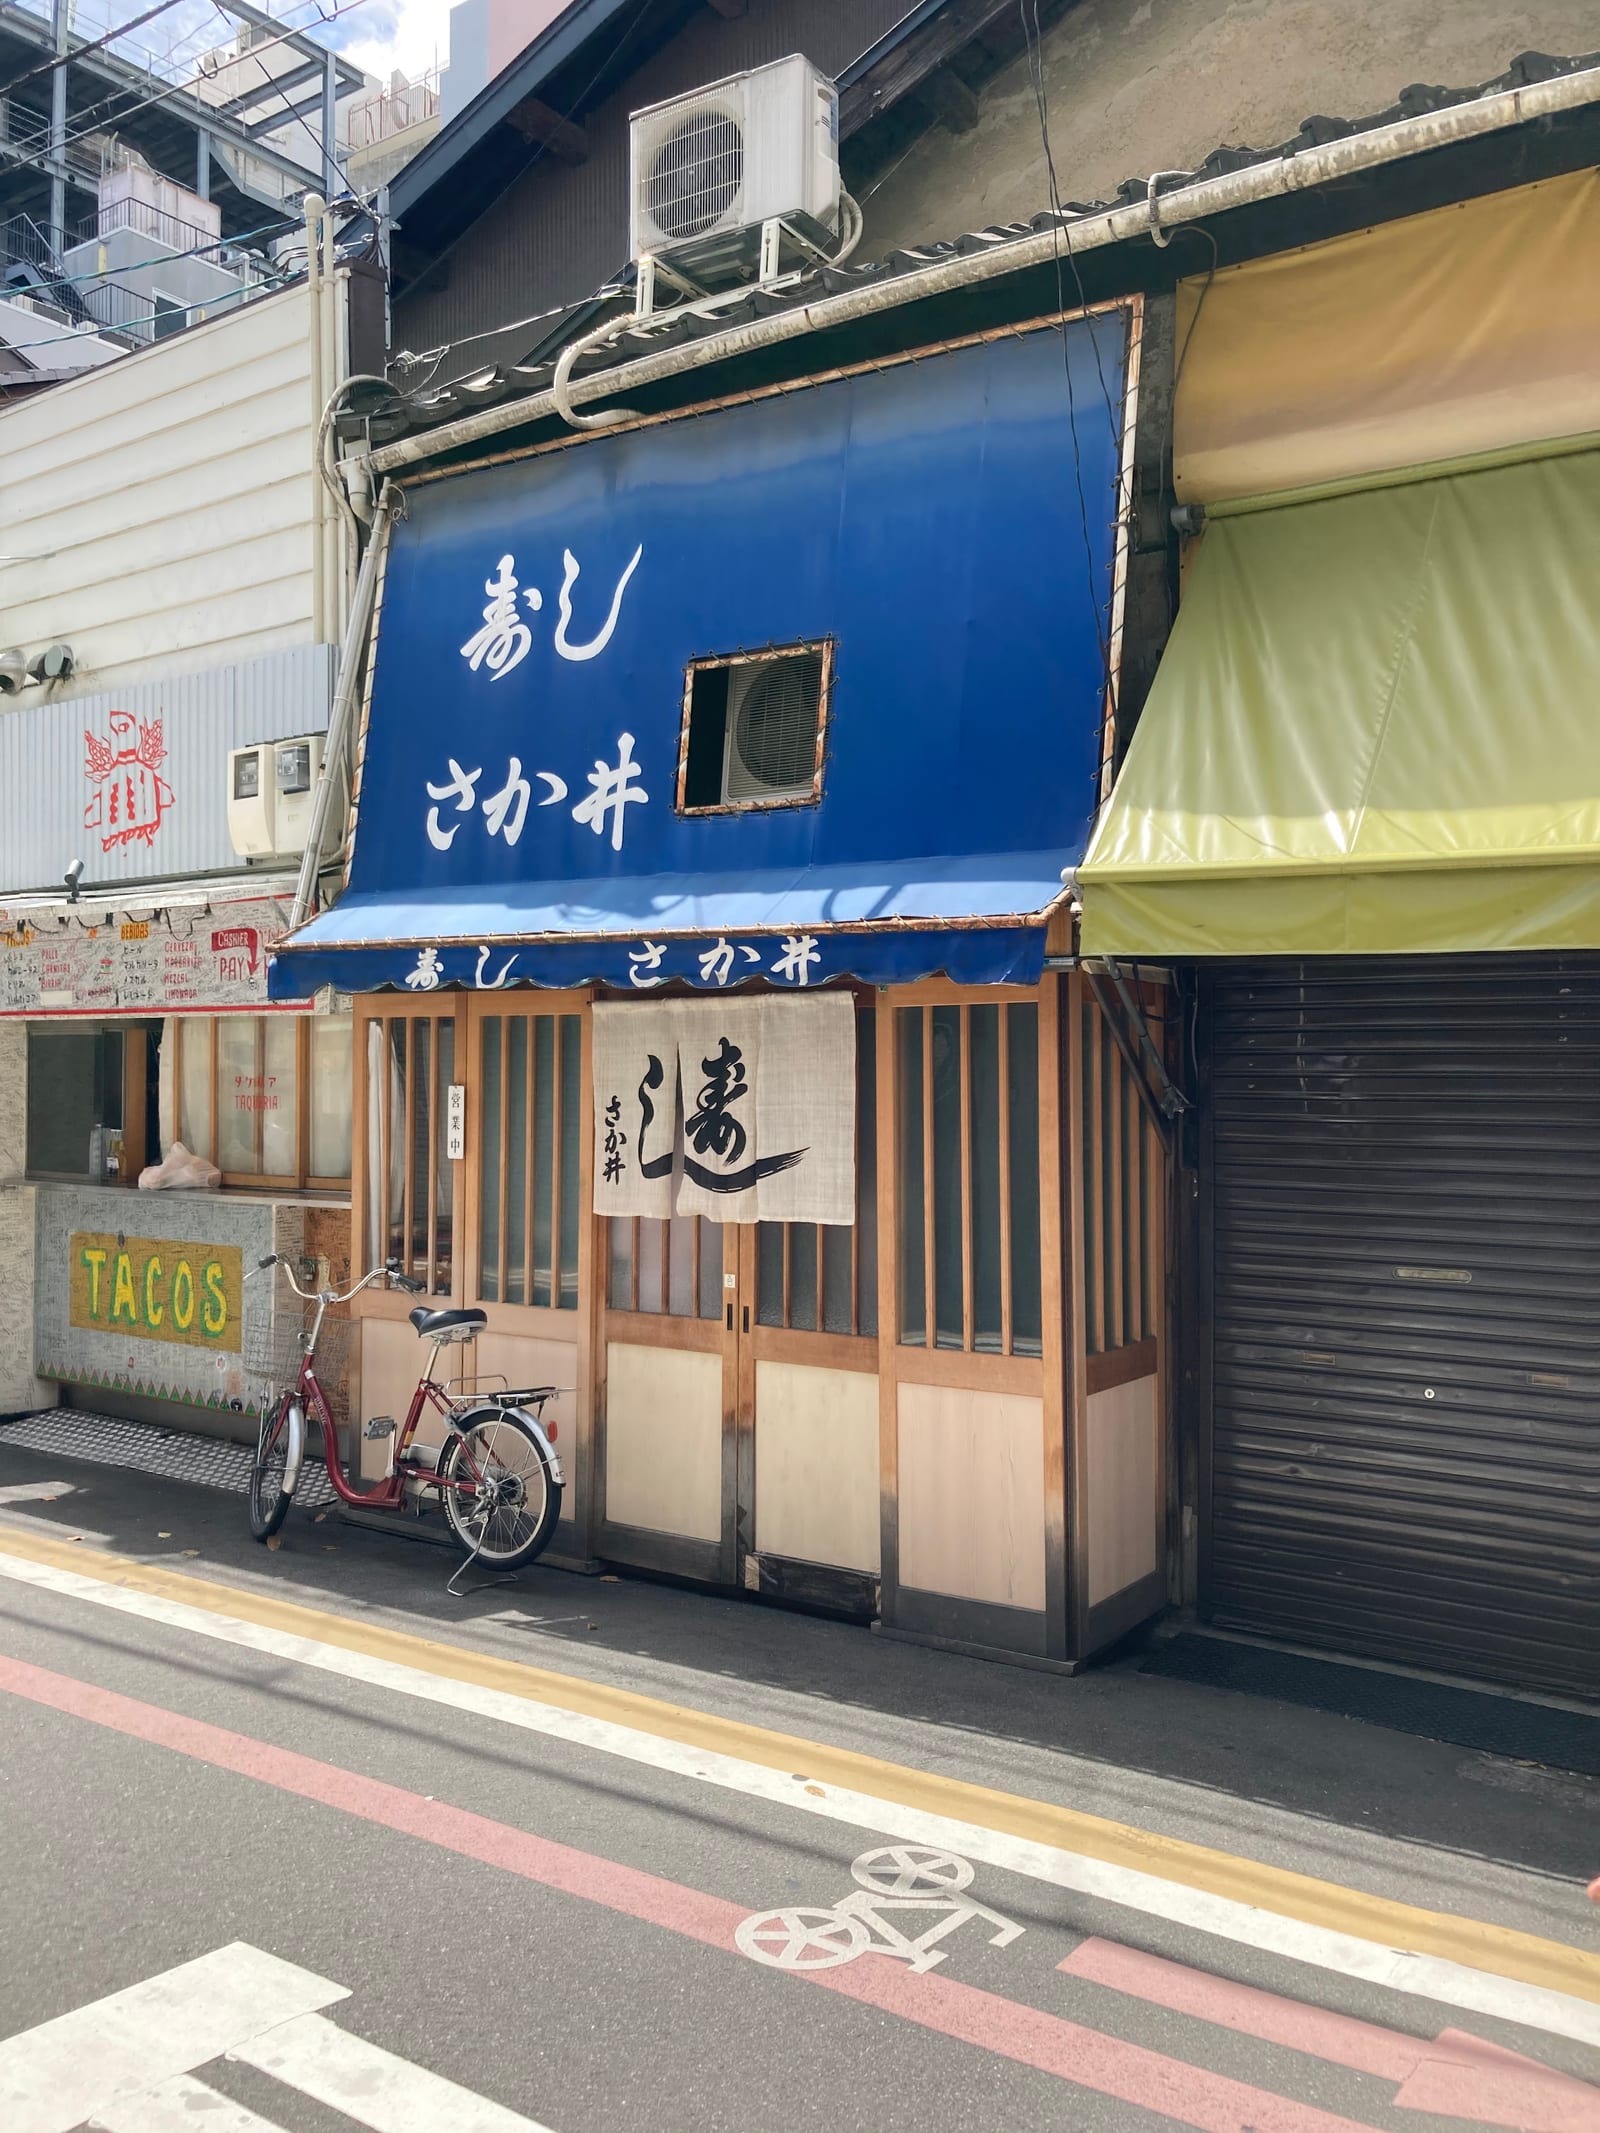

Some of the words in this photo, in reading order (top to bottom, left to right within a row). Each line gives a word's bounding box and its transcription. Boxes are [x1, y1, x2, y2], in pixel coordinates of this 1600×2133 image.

[460, 543, 643, 681] 寿し
[426, 732, 649, 851] さか井
[6, 929, 31, 947] TAOS
[121, 923, 149, 940] BEBIDAS
[218, 931, 249, 947] CASHIER
[219, 956, 244, 982] PAY
[405, 946, 519, 990] 寿し
[629, 935, 822, 988] さか井
[451, 1092, 461, 1154] 営業中
[602, 1095, 627, 1186] さか井
[81, 1248, 228, 1339] TACOS
